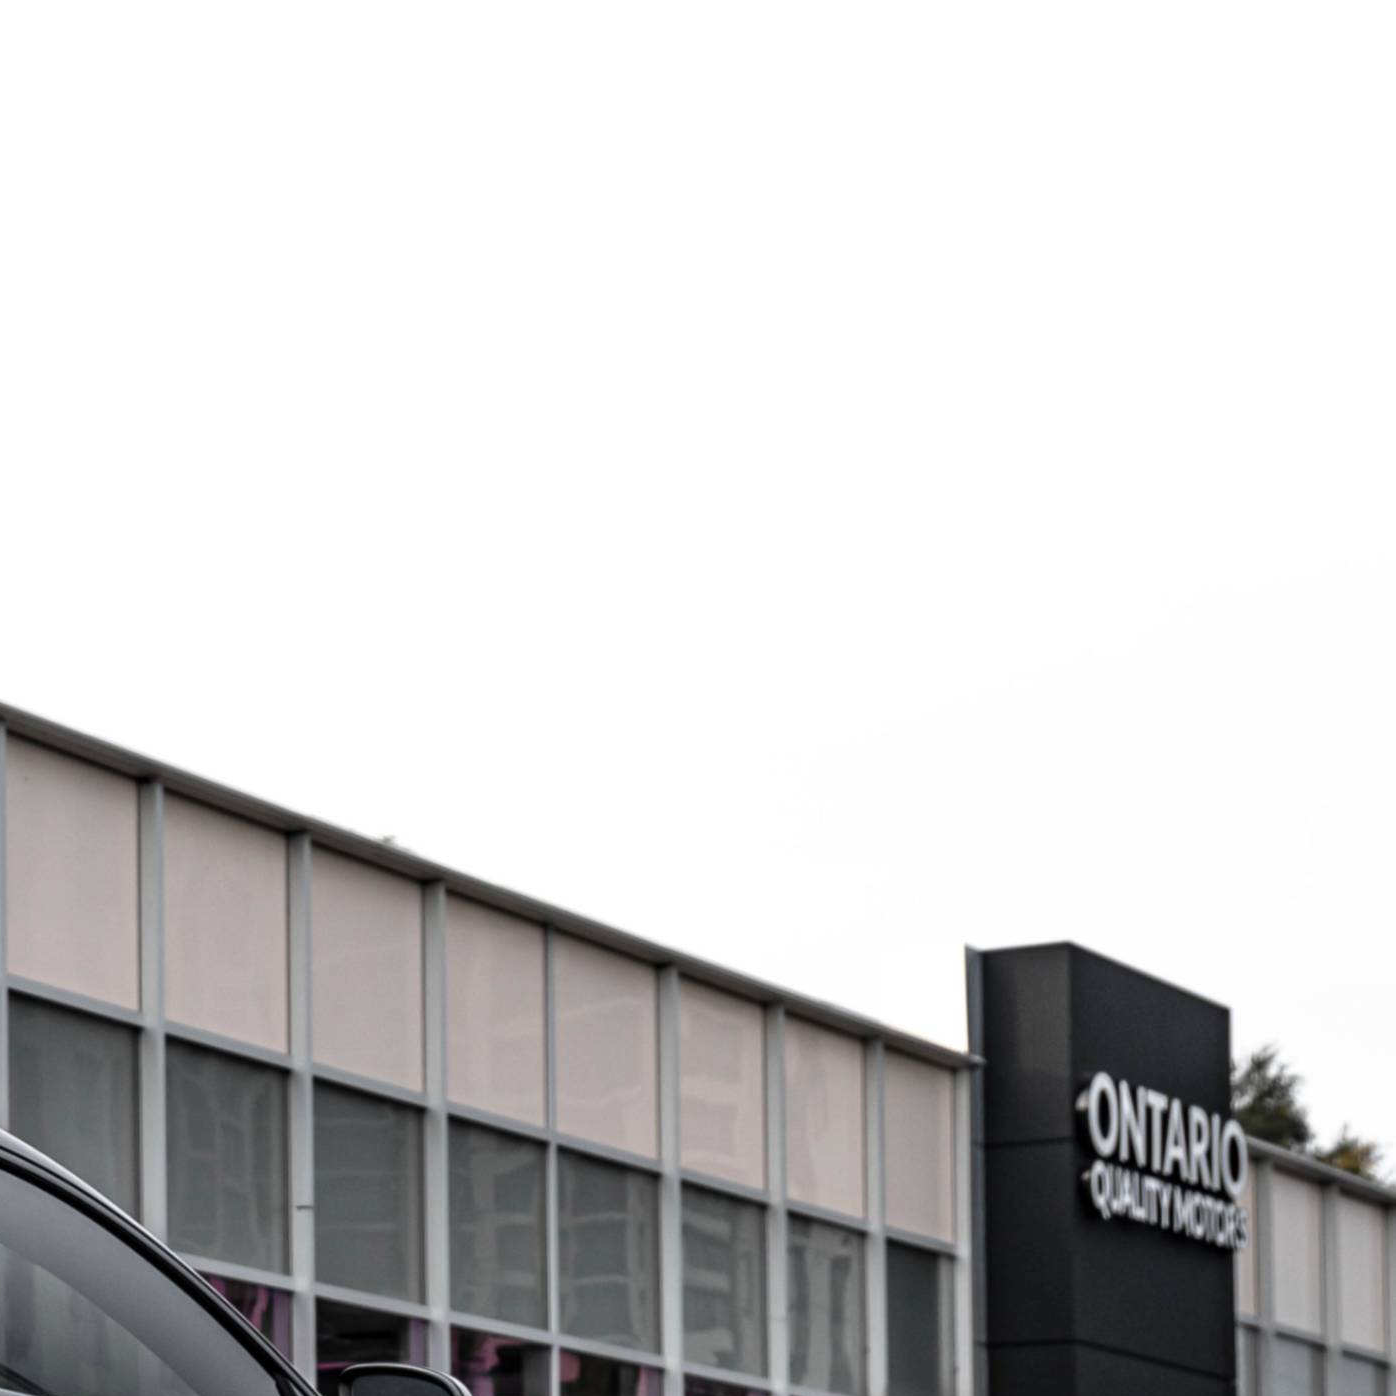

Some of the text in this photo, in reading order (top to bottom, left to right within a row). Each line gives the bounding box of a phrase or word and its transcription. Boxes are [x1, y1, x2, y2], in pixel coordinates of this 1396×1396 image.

[1088, 1071, 1249, 1201] ONTARIO
[1090, 1160, 1249, 1249] QUALITY MOTORS
